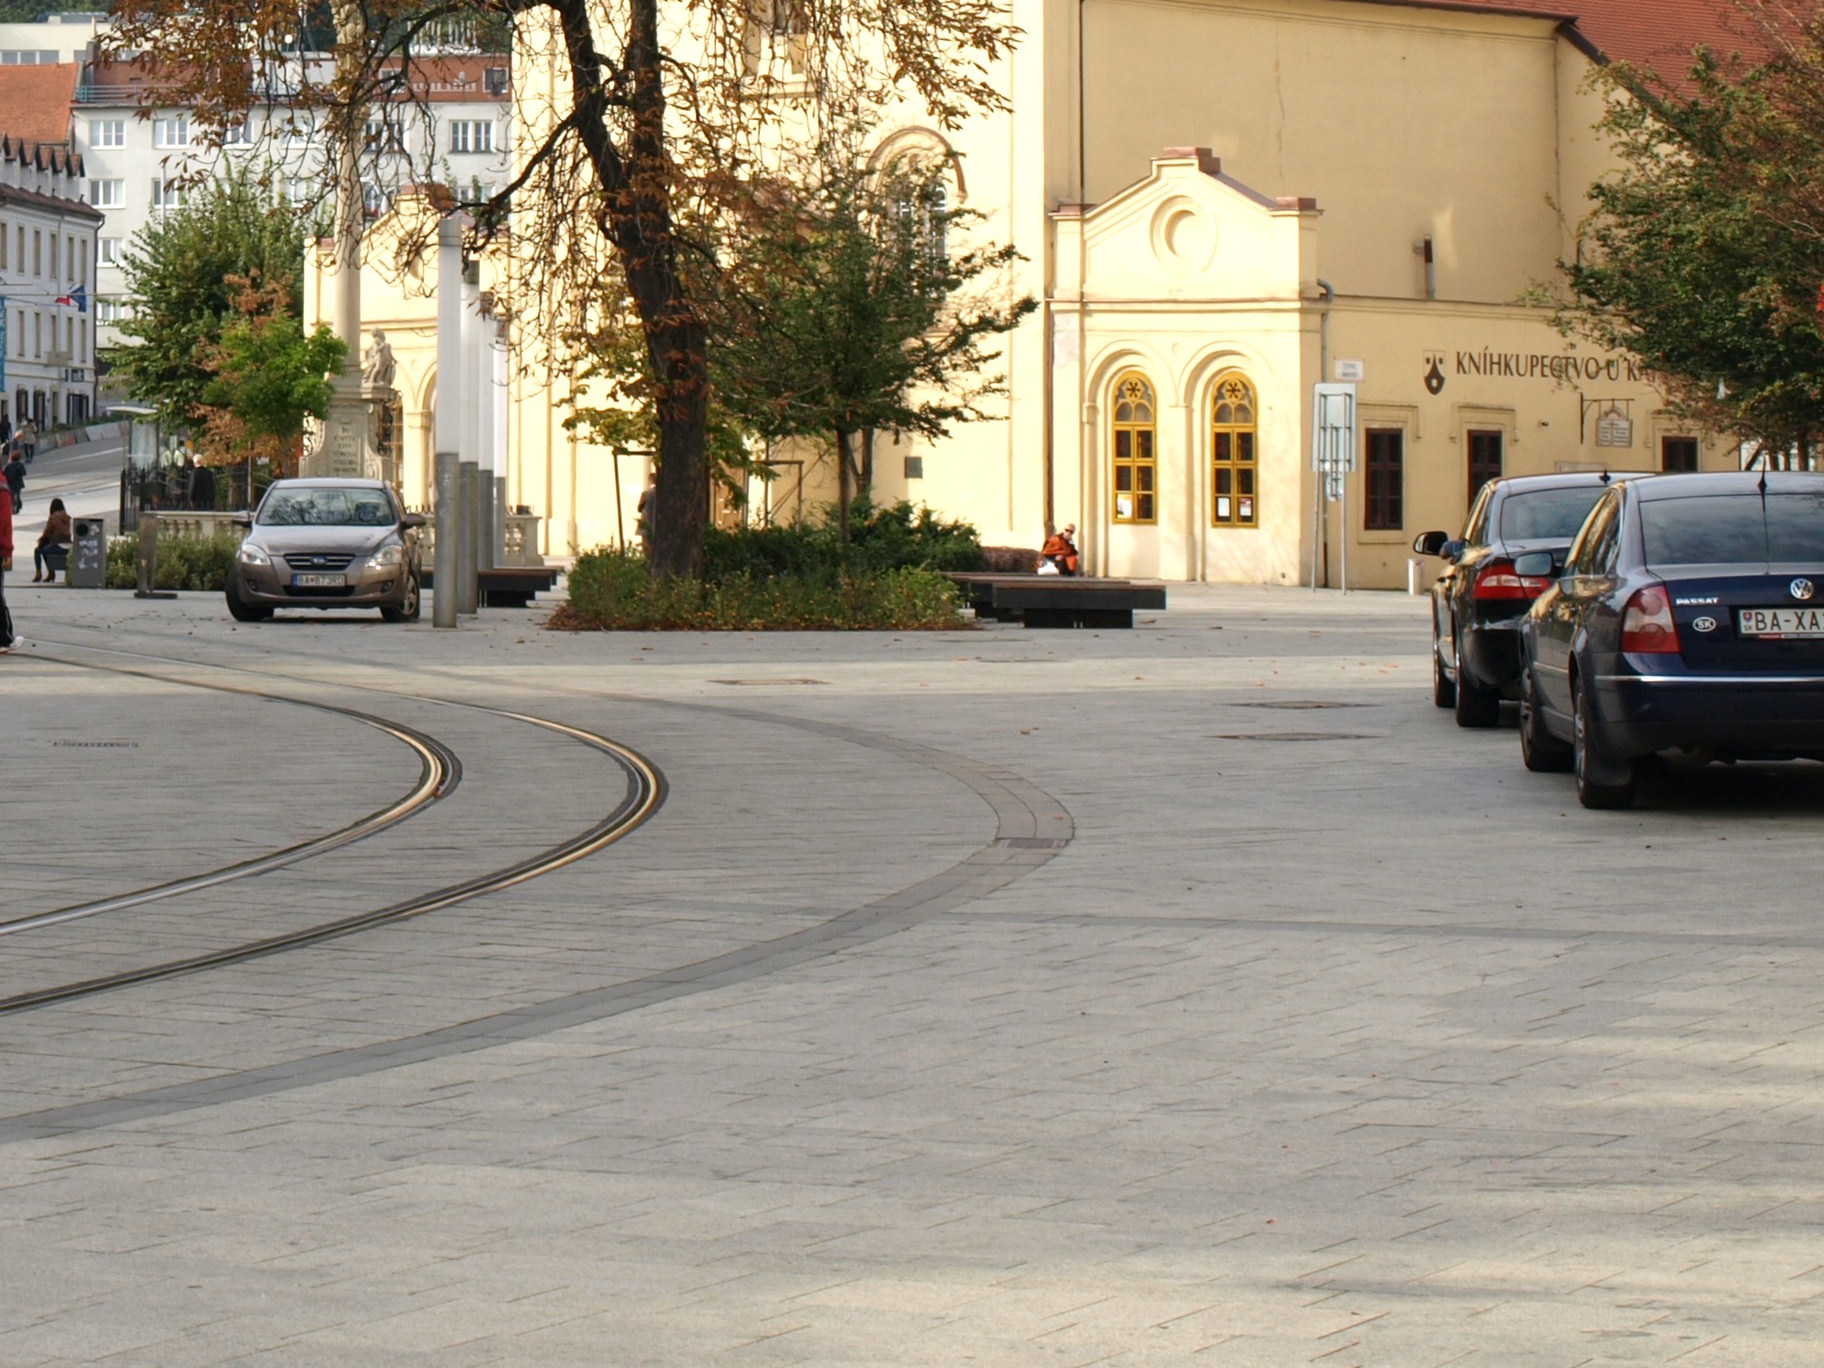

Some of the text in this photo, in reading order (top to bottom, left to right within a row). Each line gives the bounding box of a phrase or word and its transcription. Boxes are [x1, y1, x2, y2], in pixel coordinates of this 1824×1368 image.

[1456, 345, 1601, 381] KNÍHKUPECTVO
[1607, 359, 1620, 381] U
[1676, 597, 1719, 606] PASSAT
[1697, 617, 1712, 630] SK
